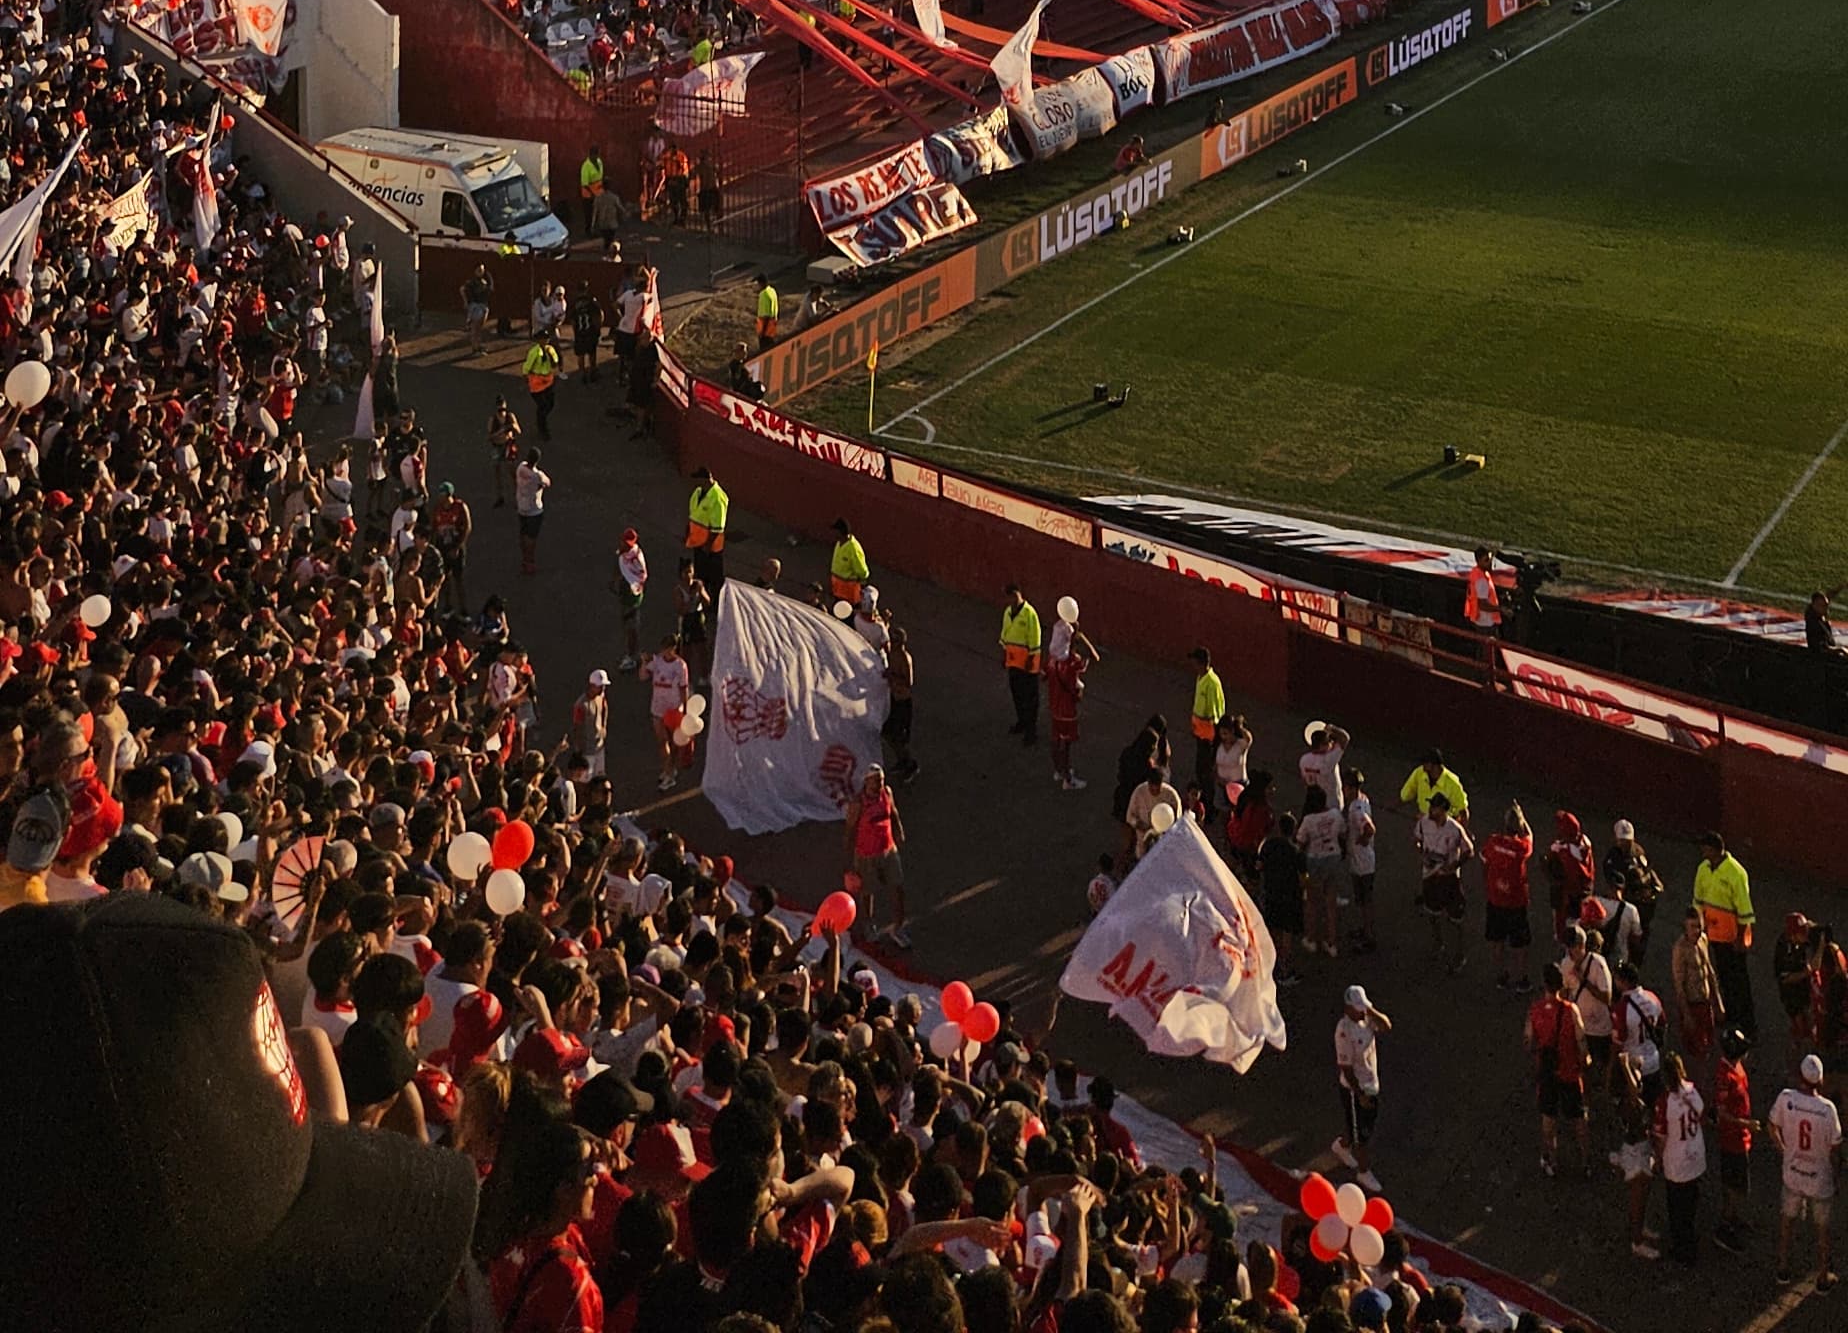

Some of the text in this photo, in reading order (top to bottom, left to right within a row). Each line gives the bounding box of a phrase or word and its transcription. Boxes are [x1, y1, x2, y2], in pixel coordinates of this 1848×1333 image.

[812, 180, 858, 223] LOS
[1040, 159, 1172, 263] LÜSQTOFF
[1798, 1118, 1812, 1151] 6
